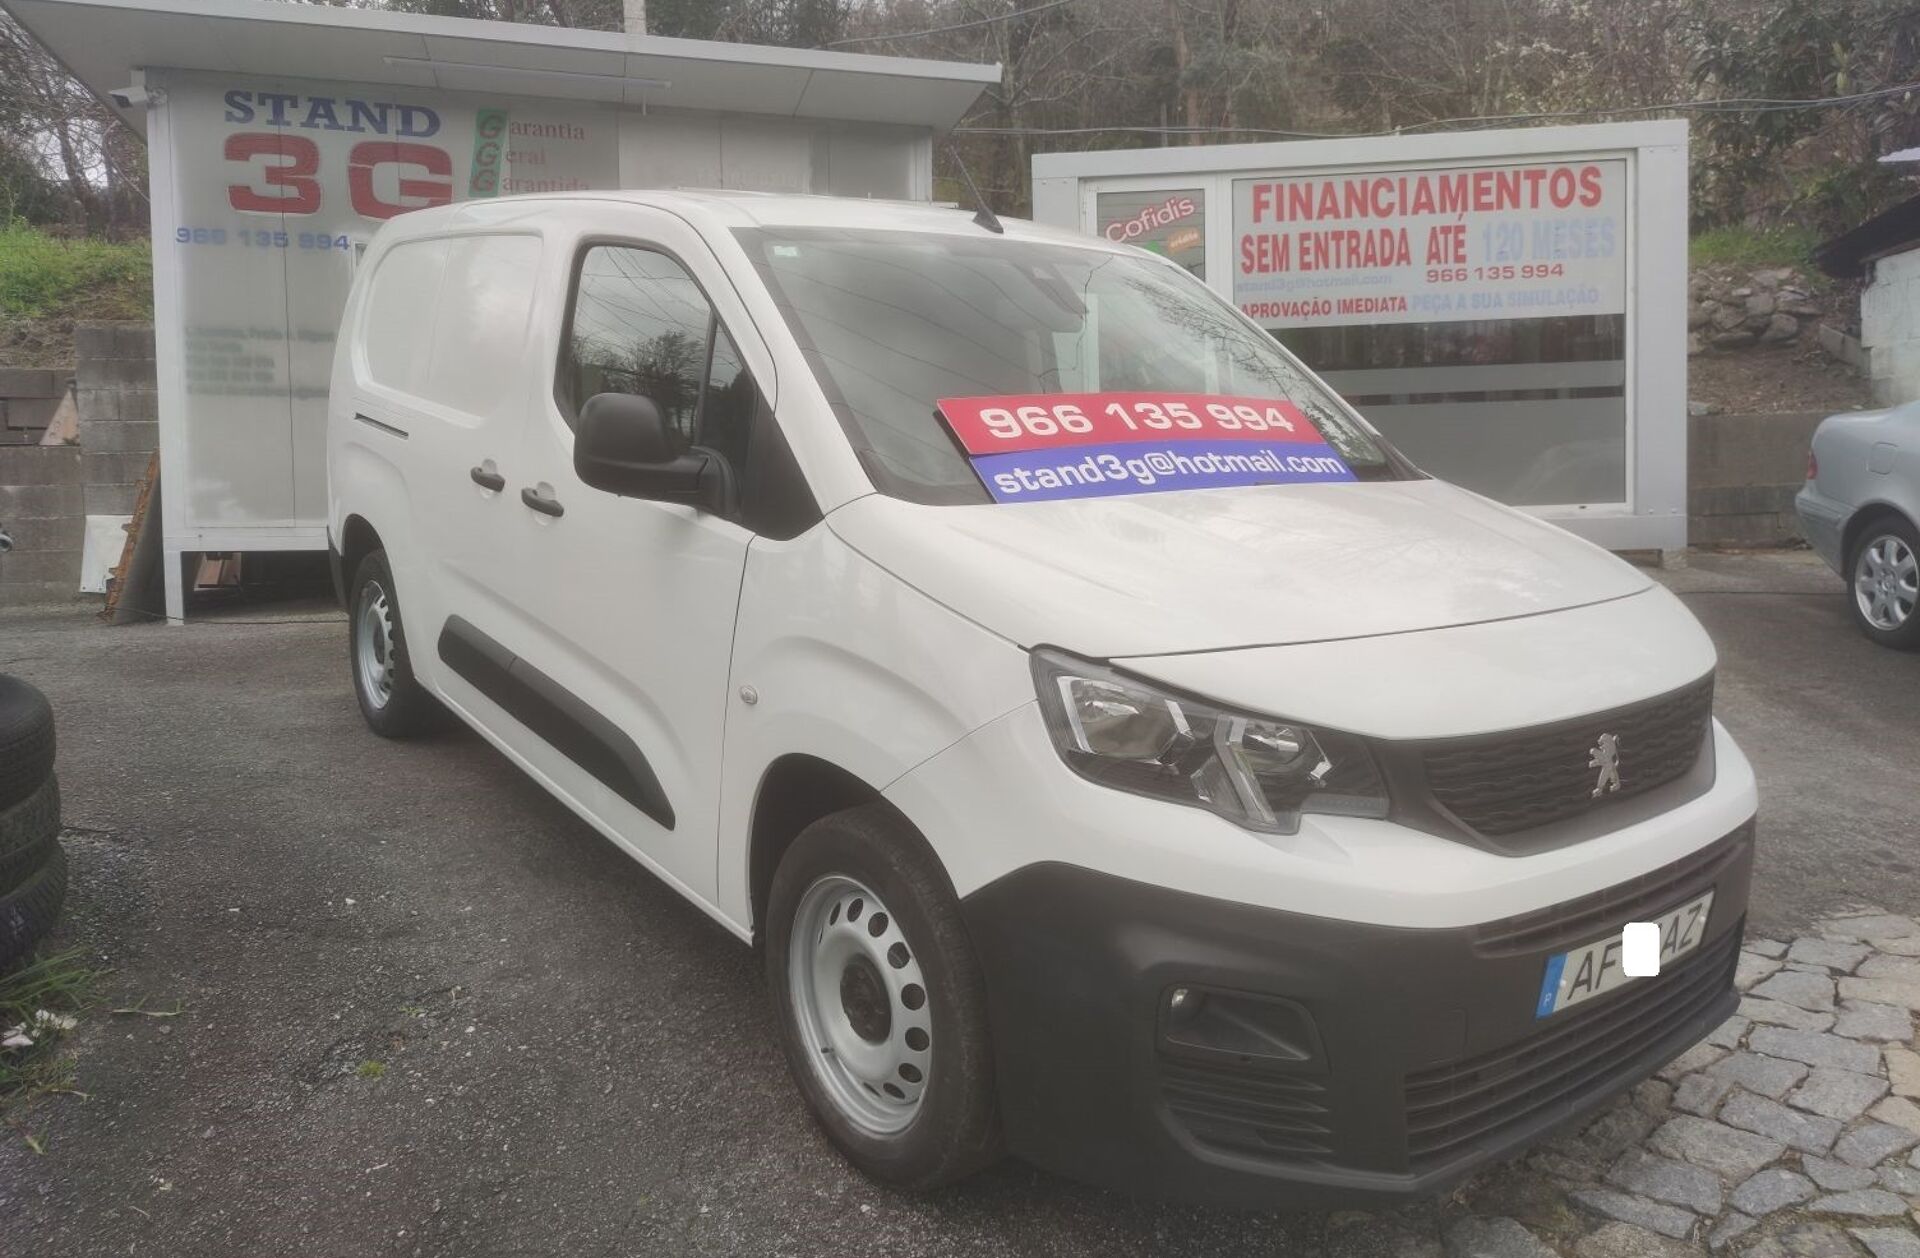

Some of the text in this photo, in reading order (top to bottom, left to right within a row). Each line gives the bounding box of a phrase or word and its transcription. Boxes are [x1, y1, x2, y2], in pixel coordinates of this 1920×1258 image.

[224, 90, 441, 138] STAND
[224, 132, 453, 220] 3G
[1252, 166, 1603, 224] FINANCIAMENTOS
[1105, 198, 1195, 243] Cofidis
[1240, 214, 1616, 275] SEM ENTRADA ATÉ 120 MESES
[1426, 263, 1565, 284] 966 135 994
[1242, 296, 1332, 320] APROVAÇÃO
[1337, 296, 1408, 314] IMEDIATA
[979, 402, 1295, 439] 966 135 994
[993, 452, 1347, 495] stand3g@hotmail.com
